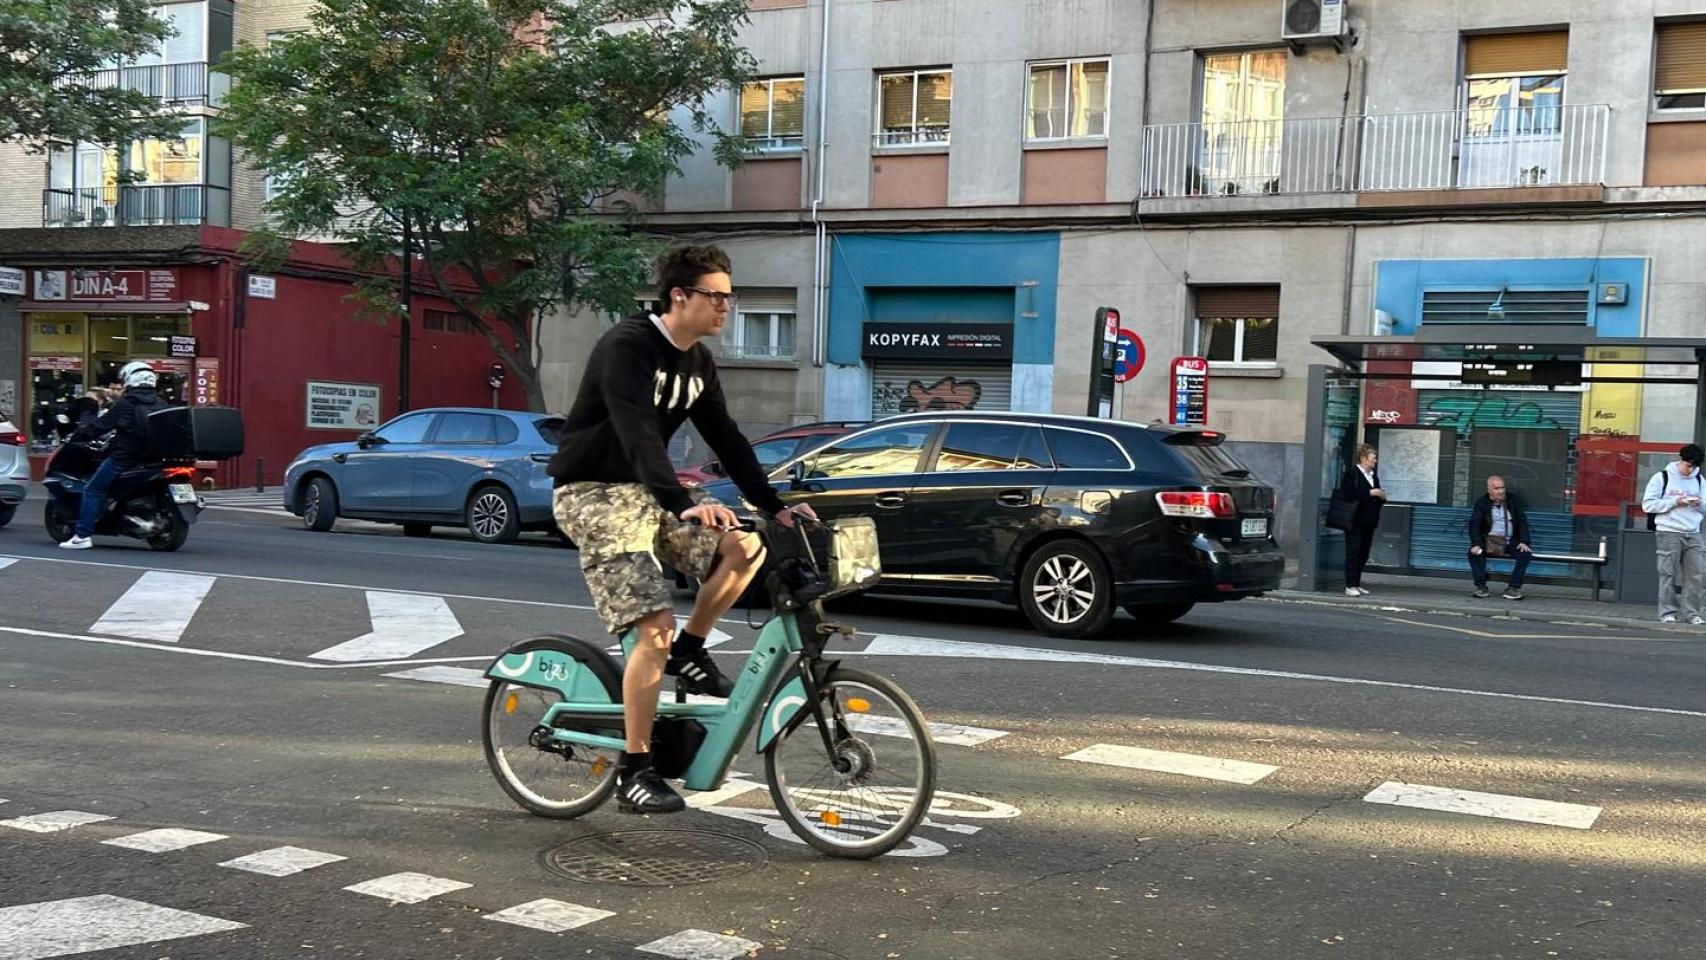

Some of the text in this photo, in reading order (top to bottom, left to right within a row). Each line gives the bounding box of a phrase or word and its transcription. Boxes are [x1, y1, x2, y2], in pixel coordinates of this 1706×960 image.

[73, 277, 129, 295] DIN A-4
[869, 333, 941, 346] KOPYFAX
[172, 344, 194, 352] COLOR
[1182, 360, 1200, 369] BUS
[1176, 375, 1188, 390] 35
[311, 385, 347, 396] FOTOCOPIAS
[1176, 394, 1187, 404] 38
[539, 656, 568, 681] bizi
